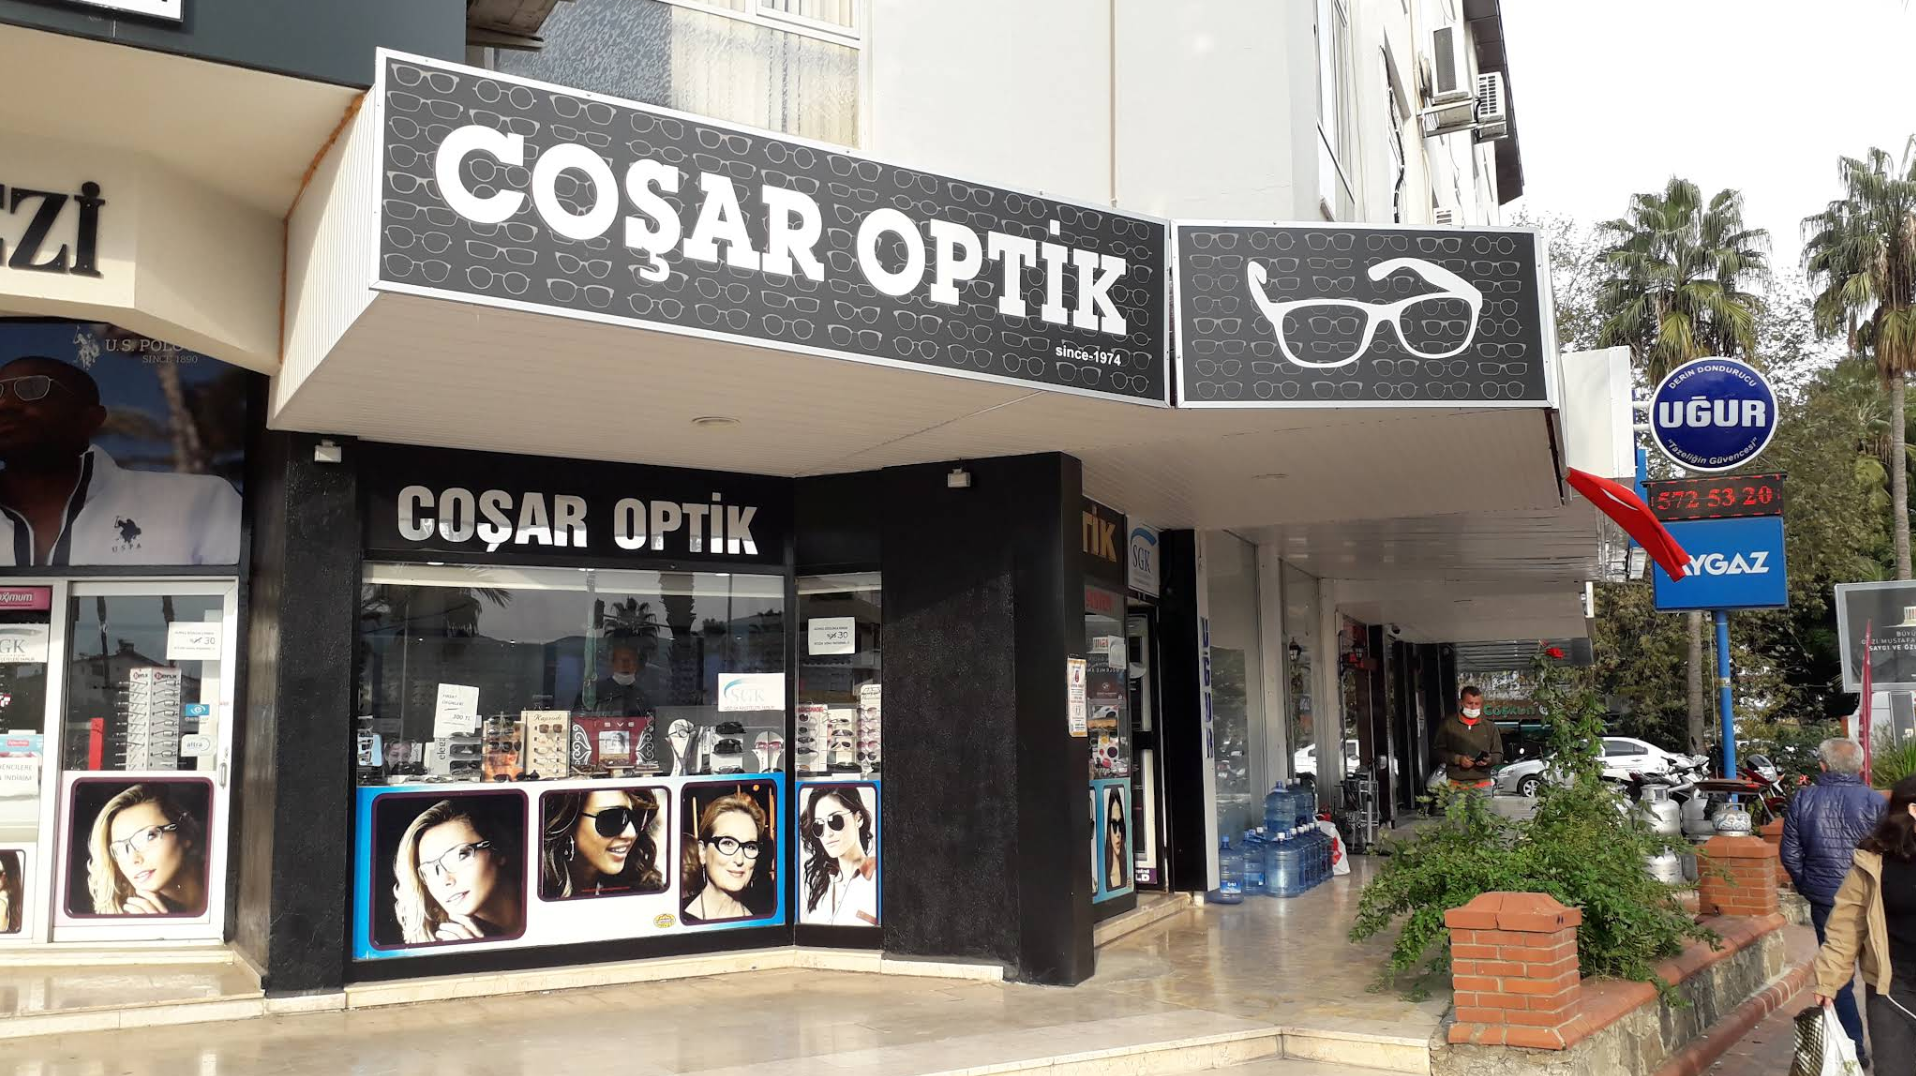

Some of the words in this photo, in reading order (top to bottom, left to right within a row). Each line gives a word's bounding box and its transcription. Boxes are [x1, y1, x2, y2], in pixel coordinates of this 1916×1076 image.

[0, 181, 106, 279] Zİ
[434, 124, 825, 283] COŞAR
[857, 207, 1127, 336] OPTİK
[1055, 345, 1121, 366] since-1974
[1668, 369, 1695, 390] DERİN
[1696, 365, 1757, 387] DONDURUCU
[1659, 395, 1766, 429] UĞUR
[1657, 490, 1700, 510] 572
[1708, 487, 1736, 507] 53
[1742, 485, 1773, 505] 20
[397, 485, 588, 552] COŞAR
[613, 492, 759, 555] OPTİK
[1668, 551, 1770, 577] YGAZ
